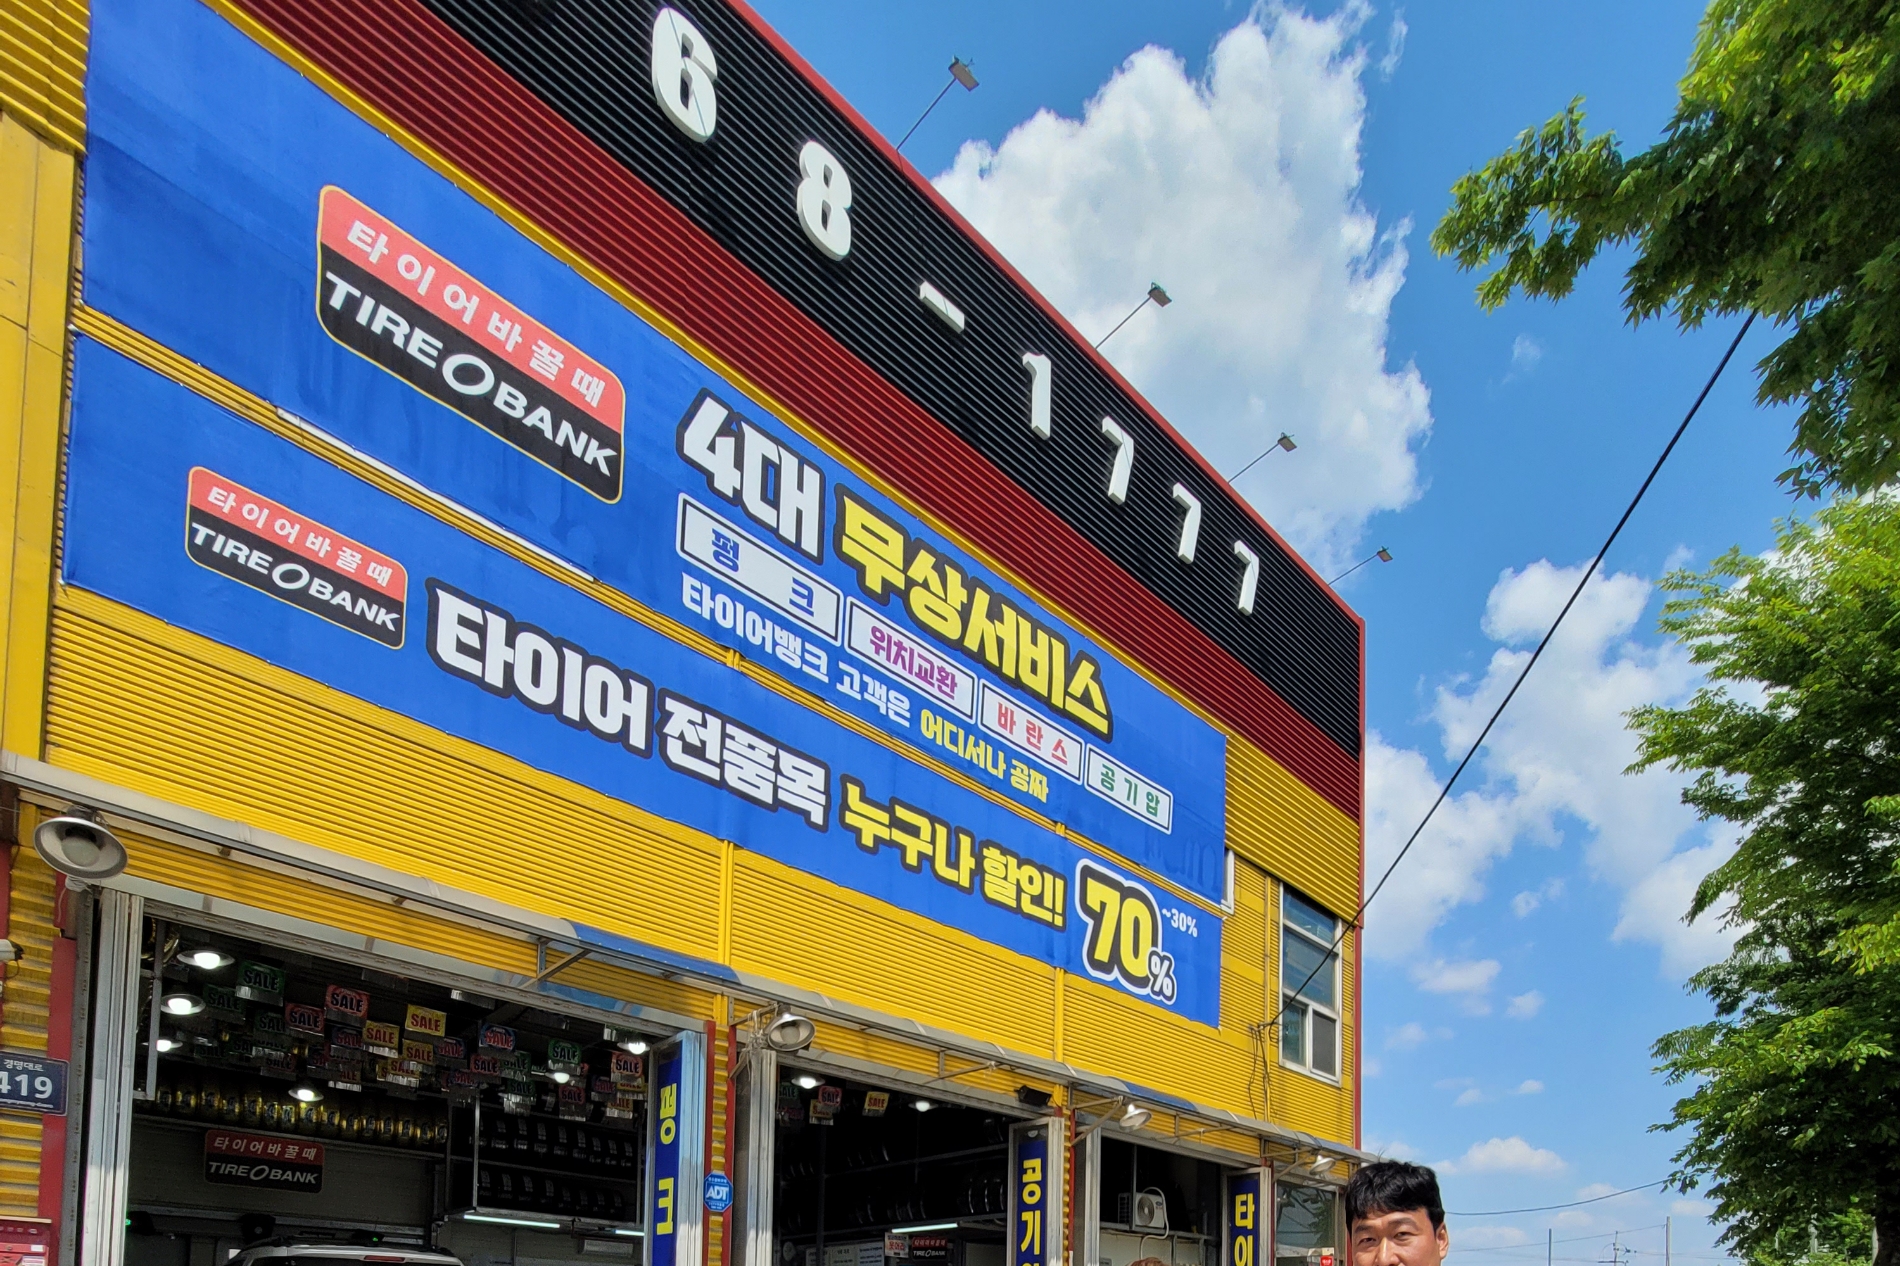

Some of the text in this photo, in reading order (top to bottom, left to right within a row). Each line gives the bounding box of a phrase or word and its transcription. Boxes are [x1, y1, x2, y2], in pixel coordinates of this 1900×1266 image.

[683, 396, 1109, 736] 4대 무상서비스
[869, 624, 958, 701] 위치교환
[682, 571, 1050, 804] 타이어뱅크 고객은 어디서나 공짜
[435, 587, 649, 751] 타이어
[662, 696, 827, 826] 전품목
[844, 782, 976, 889] 누구나
[981, 845, 1066, 927] 할인!
[1160, 907, 1198, 938] ~30%
[243, 969, 279, 992] SALE
[208, 992, 240, 1010] SALE
[330, 993, 364, 1013] SALE
[289, 1011, 321, 1031] SALE
[411, 1013, 442, 1032] SALE
[366, 1029, 395, 1045] SALE
[484, 1031, 514, 1050] SALE
[406, 1046, 433, 1063] SALE
[553, 1046, 579, 1063] SALE
[3, 1059, 45, 1072] 경명대로
[473, 1058, 498, 1075] SALE
[616, 1057, 640, 1074] SALE
[511, 1082, 533, 1096] SALE
[561, 1088, 582, 1104] SALE
[867, 1097, 886, 1108] SALE
[705, 1185, 729, 1201] ADT
